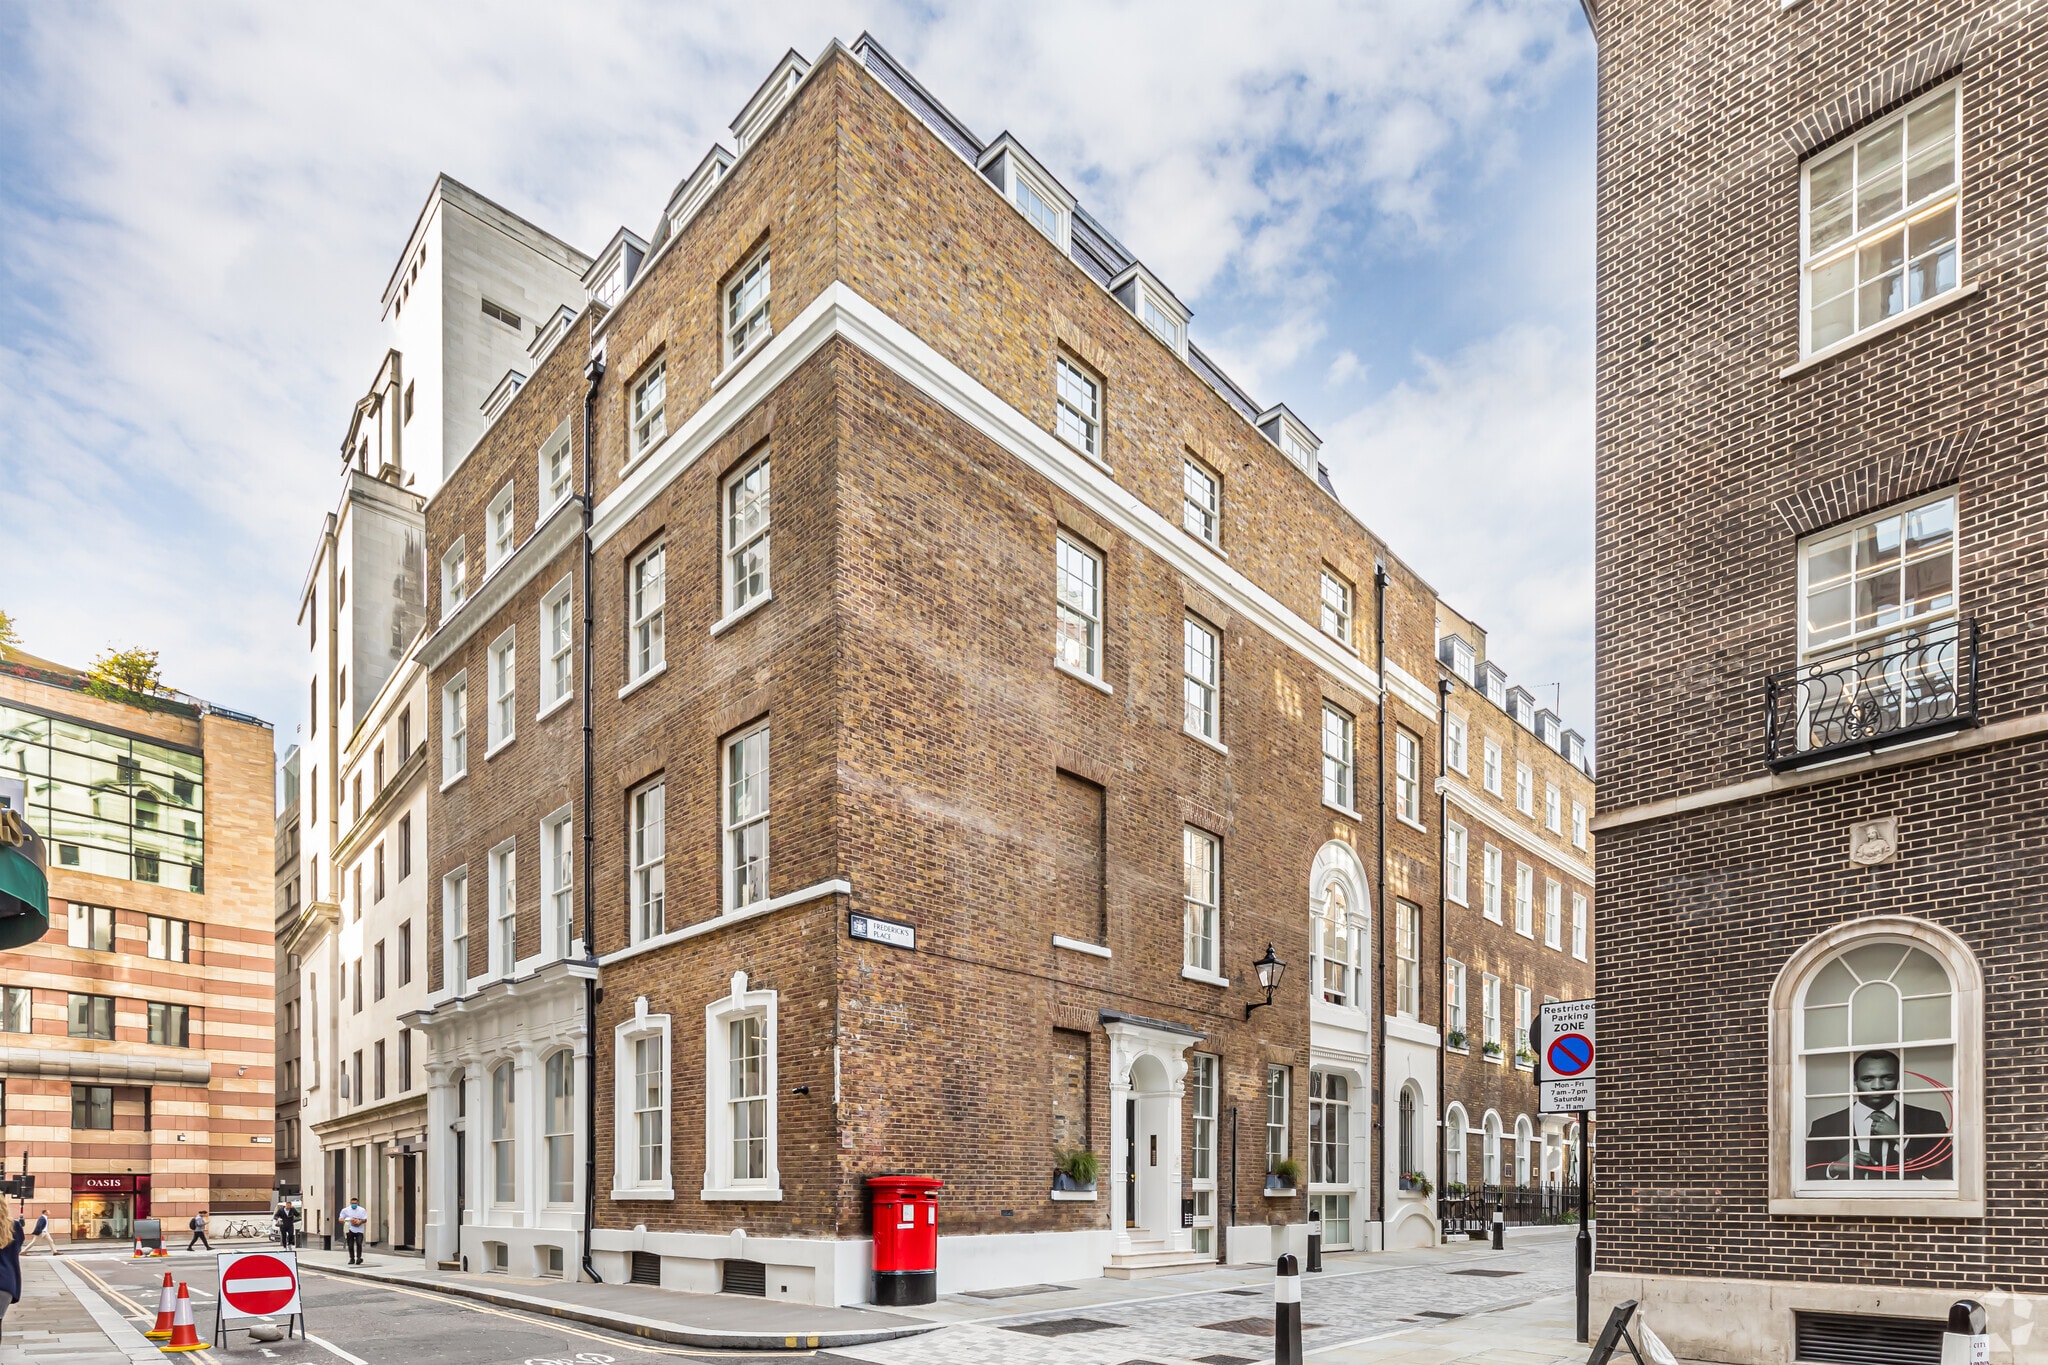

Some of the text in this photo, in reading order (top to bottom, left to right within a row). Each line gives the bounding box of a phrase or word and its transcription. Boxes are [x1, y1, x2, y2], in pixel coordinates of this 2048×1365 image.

[873, 922, 909, 936] FREDERICK'S
[873, 931, 891, 940] PLACE
[1551, 1013, 1588, 1022] Parking
[1554, 1021, 1585, 1032] ZONE
[87, 1179, 121, 1187] OASIS
